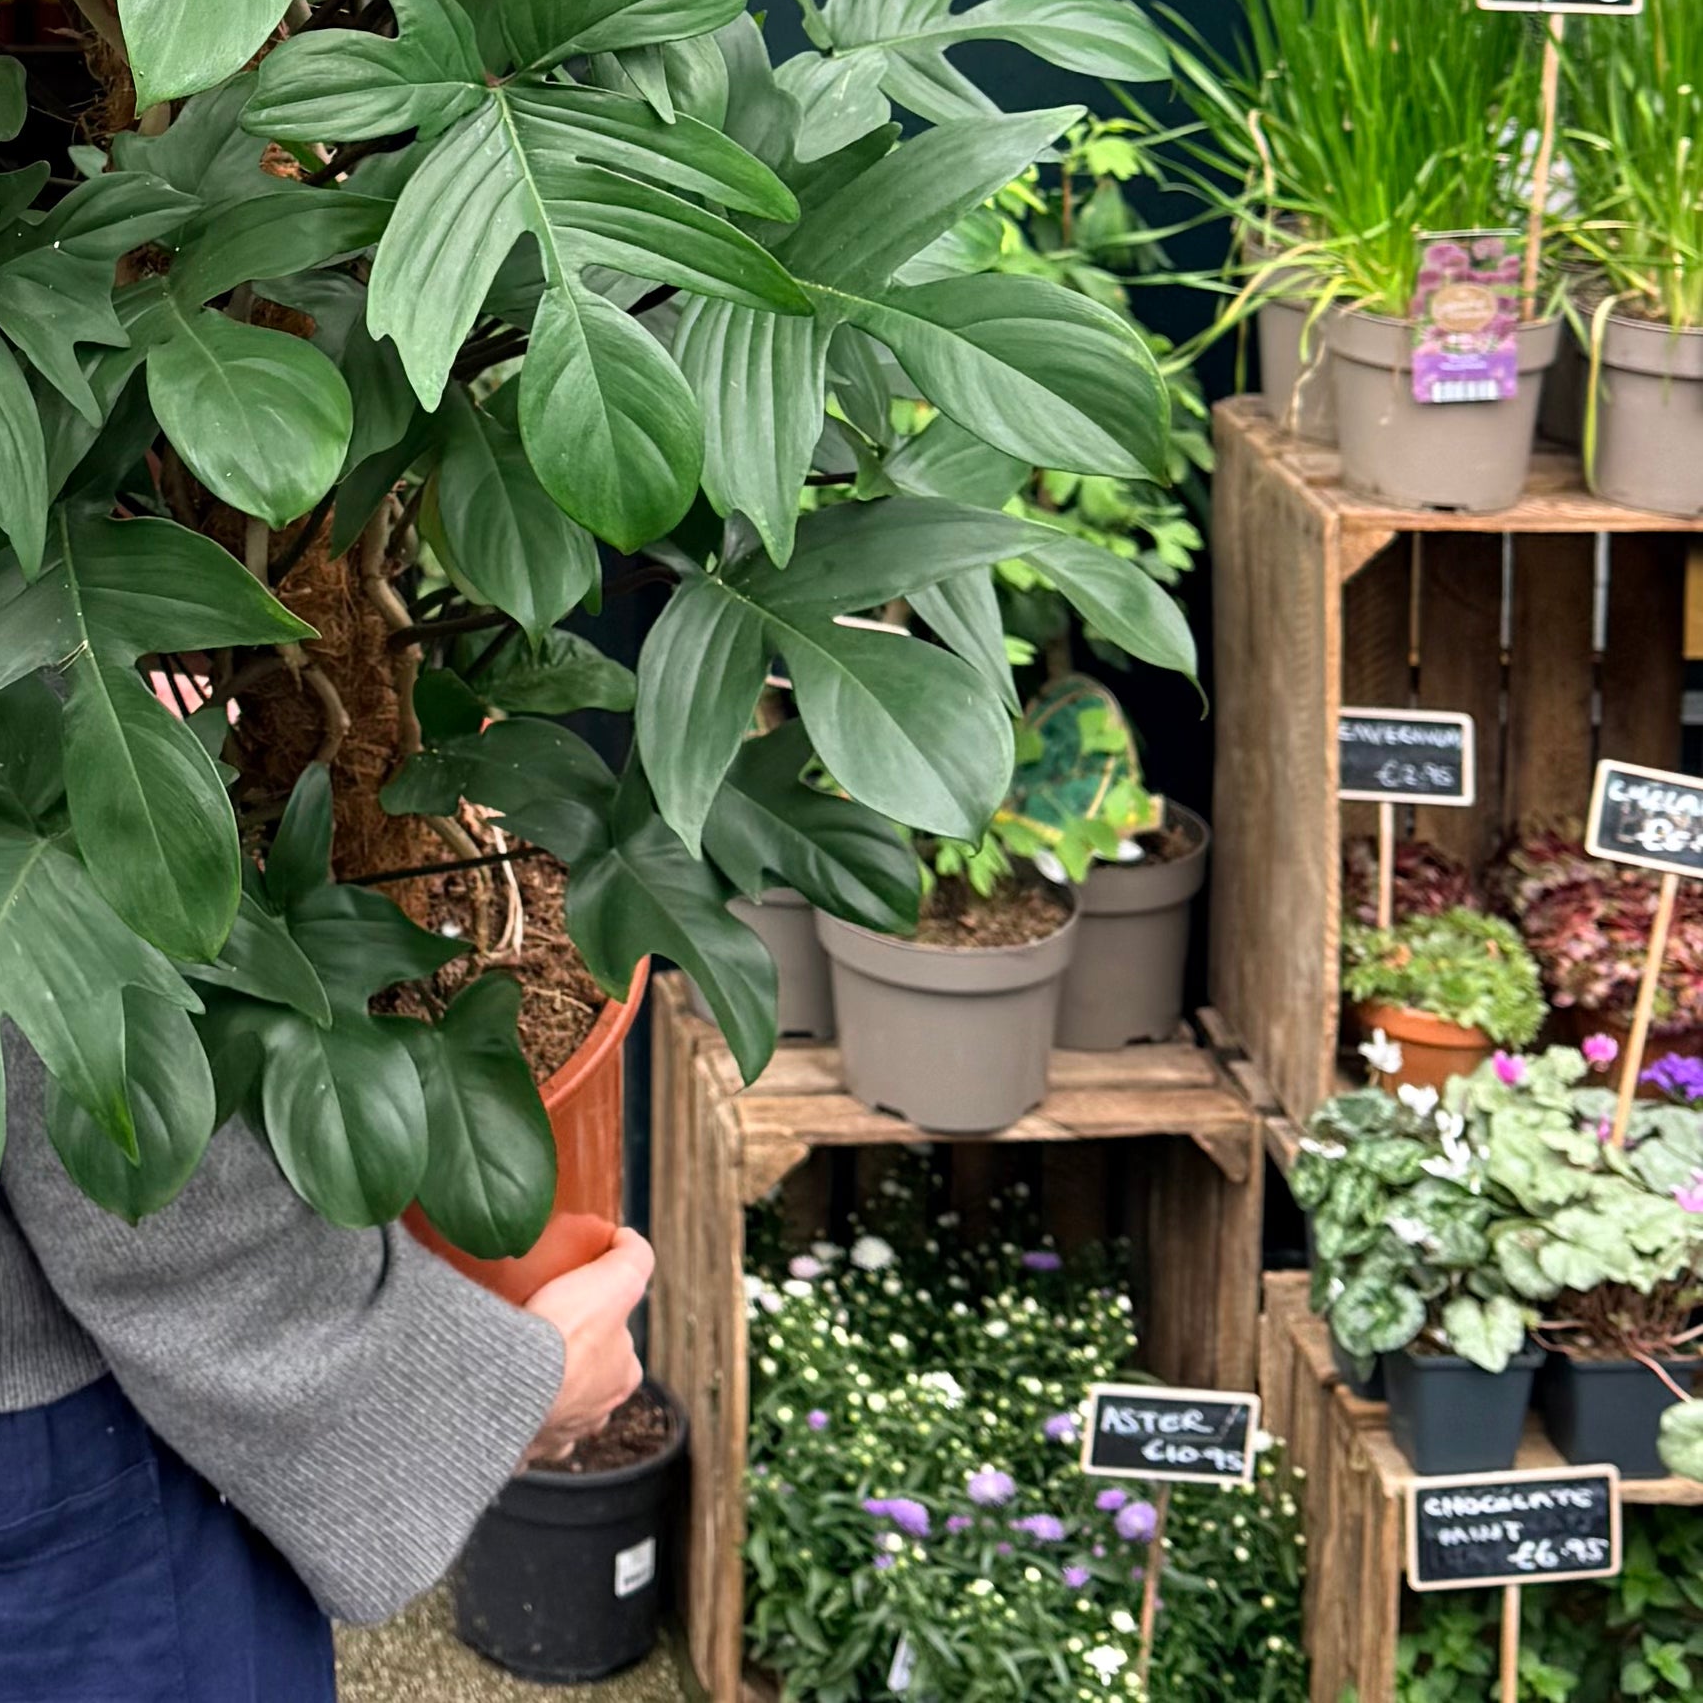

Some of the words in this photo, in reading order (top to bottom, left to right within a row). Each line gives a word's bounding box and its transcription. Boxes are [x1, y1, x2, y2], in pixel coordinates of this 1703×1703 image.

[1101, 1405, 1215, 1434] ASTER
[1424, 1488, 1595, 1518] CHOCOLATE
[1507, 1537, 1610, 1571] £6.95
